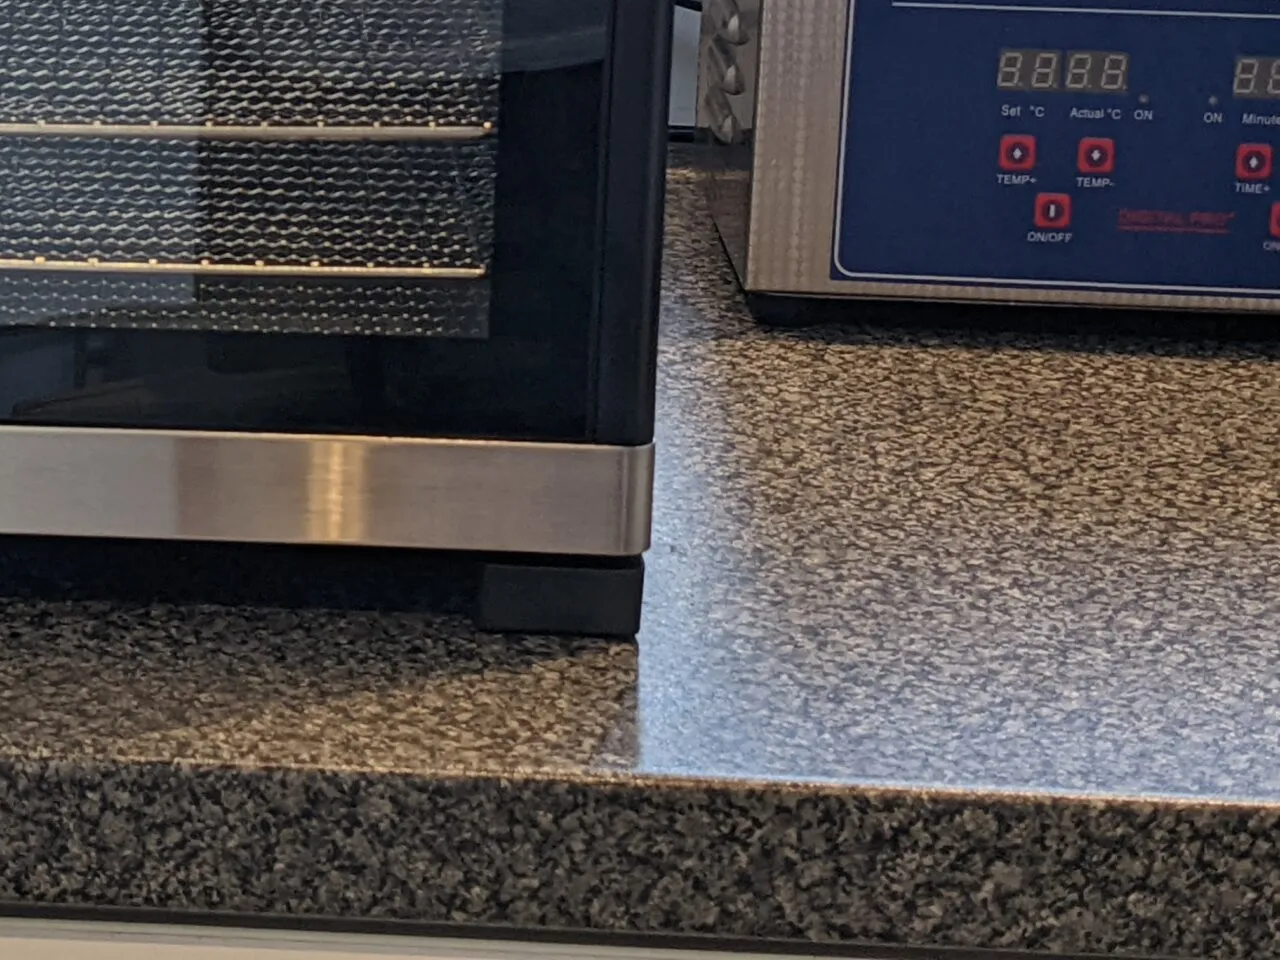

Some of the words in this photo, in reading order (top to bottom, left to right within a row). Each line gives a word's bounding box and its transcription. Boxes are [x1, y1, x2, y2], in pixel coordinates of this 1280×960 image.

[1001, 104, 1021, 117] Set
[1070, 107, 1104, 119] Actual
[1133, 109, 1153, 121] ON
[1203, 112, 1223, 123] ON
[996, 174, 1037, 185] TEMP+
